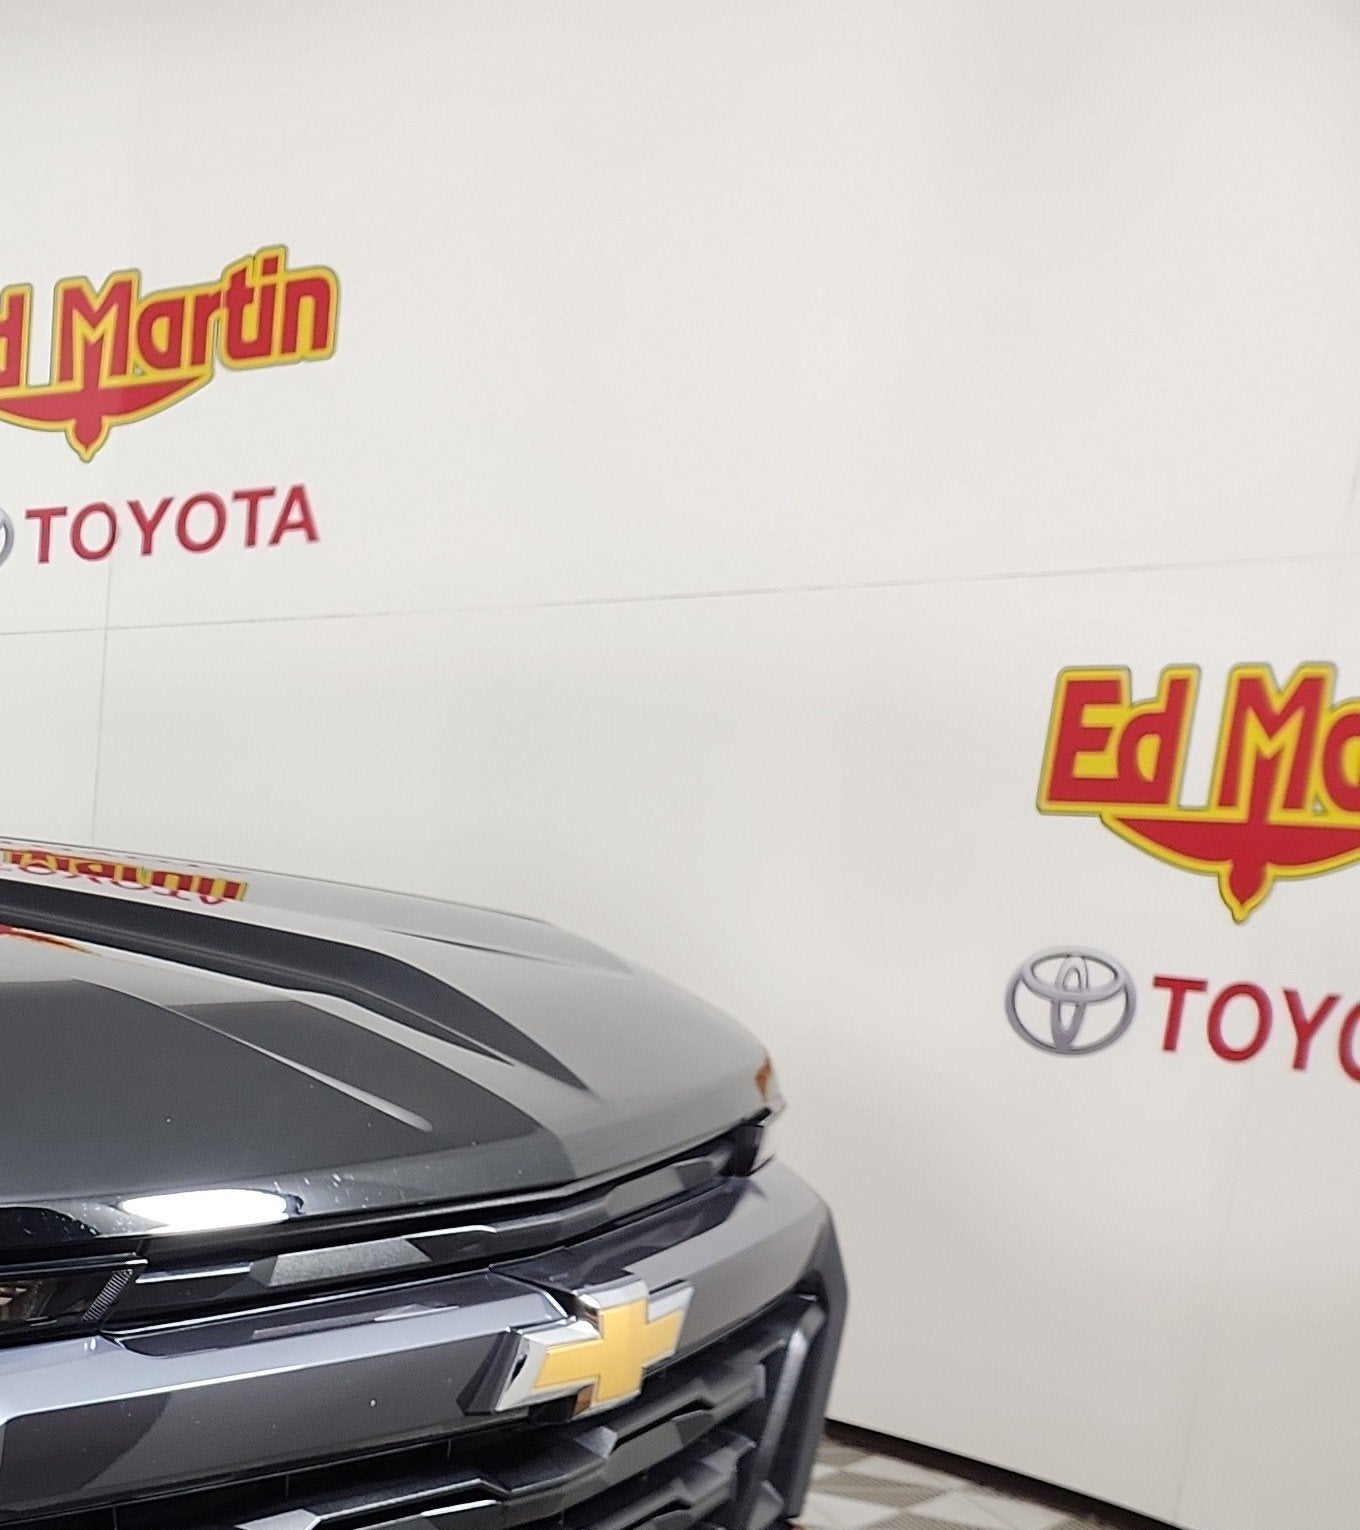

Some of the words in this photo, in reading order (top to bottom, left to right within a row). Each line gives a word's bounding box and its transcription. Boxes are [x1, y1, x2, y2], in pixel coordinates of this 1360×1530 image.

[48, 243, 340, 392] Martin
[24, 483, 321, 565] TOYOTA
[1036, 664, 1201, 814] Ed
